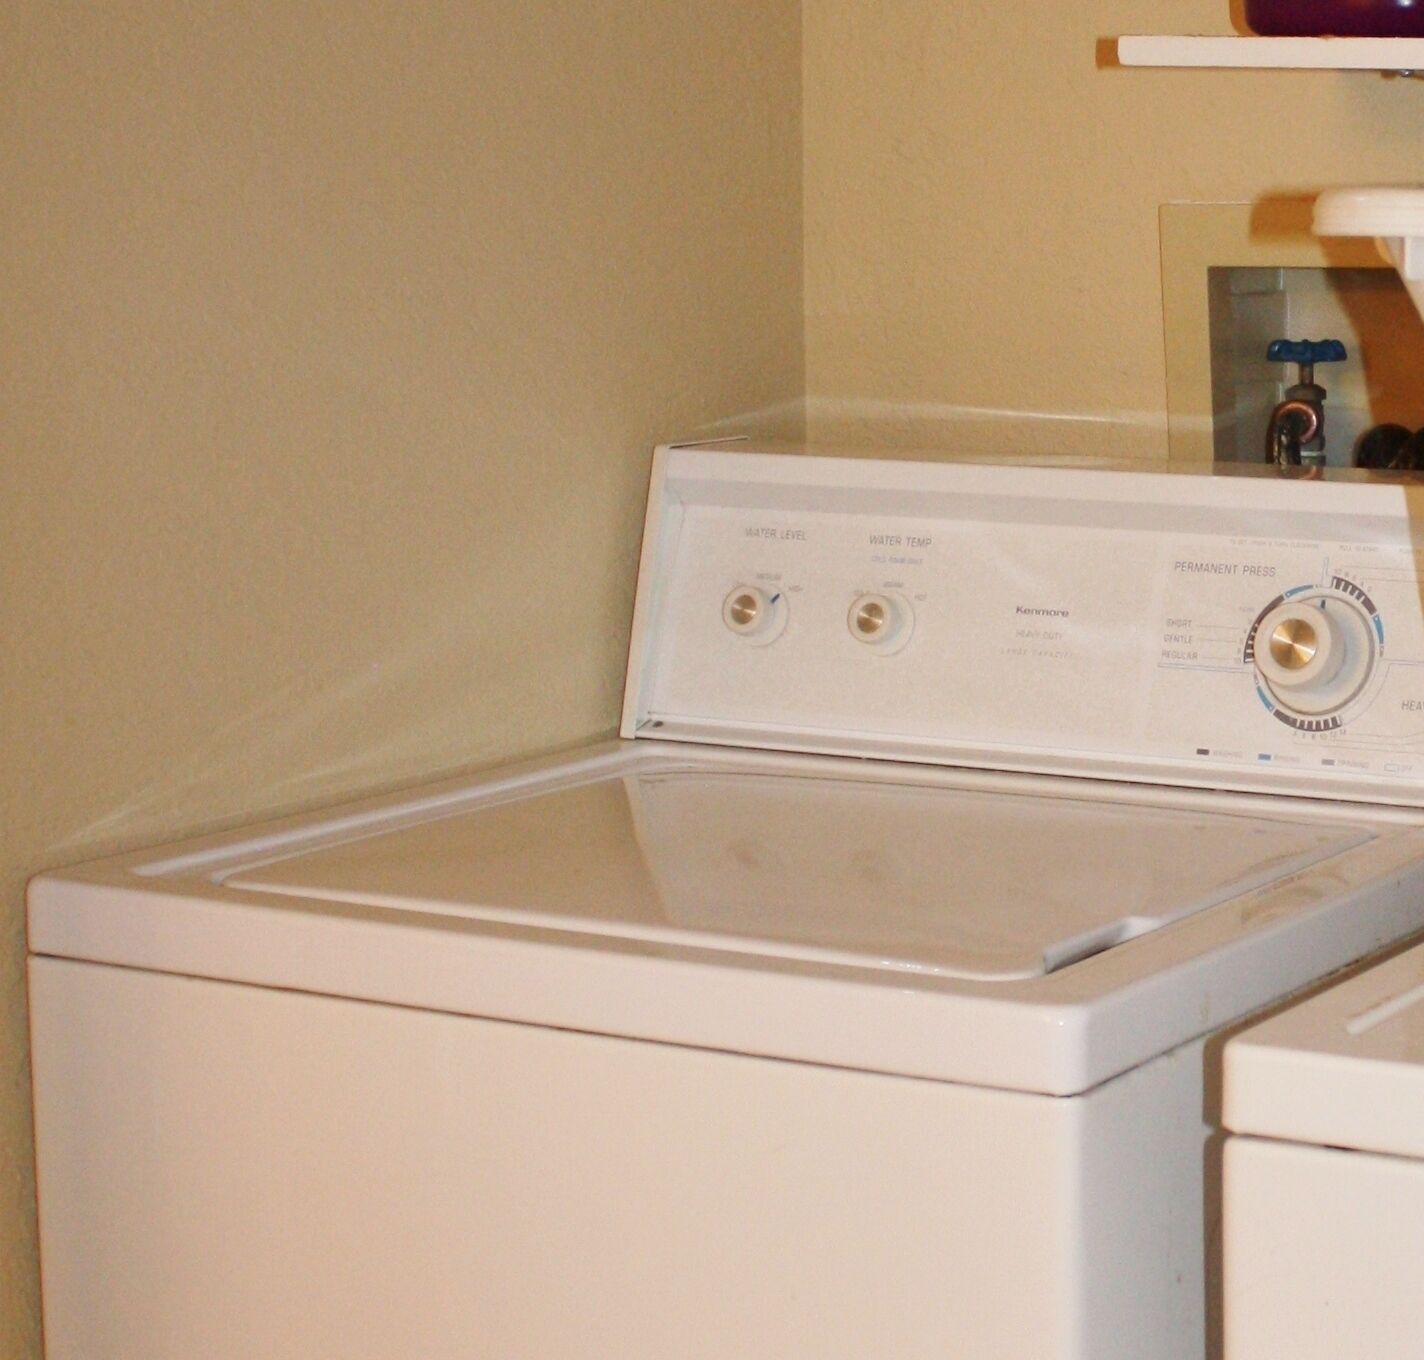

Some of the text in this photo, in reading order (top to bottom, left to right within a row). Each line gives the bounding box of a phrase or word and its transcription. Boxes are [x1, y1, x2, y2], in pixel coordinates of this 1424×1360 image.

[745, 528, 807, 541] WATER LEVEL
[869, 535, 932, 548] WATER TEMP
[1174, 561, 1276, 577] PERMANENT PRESS
[1015, 606, 1069, 618] Kenmore
[1163, 633, 1193, 644] GENTLE
[1162, 649, 1198, 660] REGULAR
